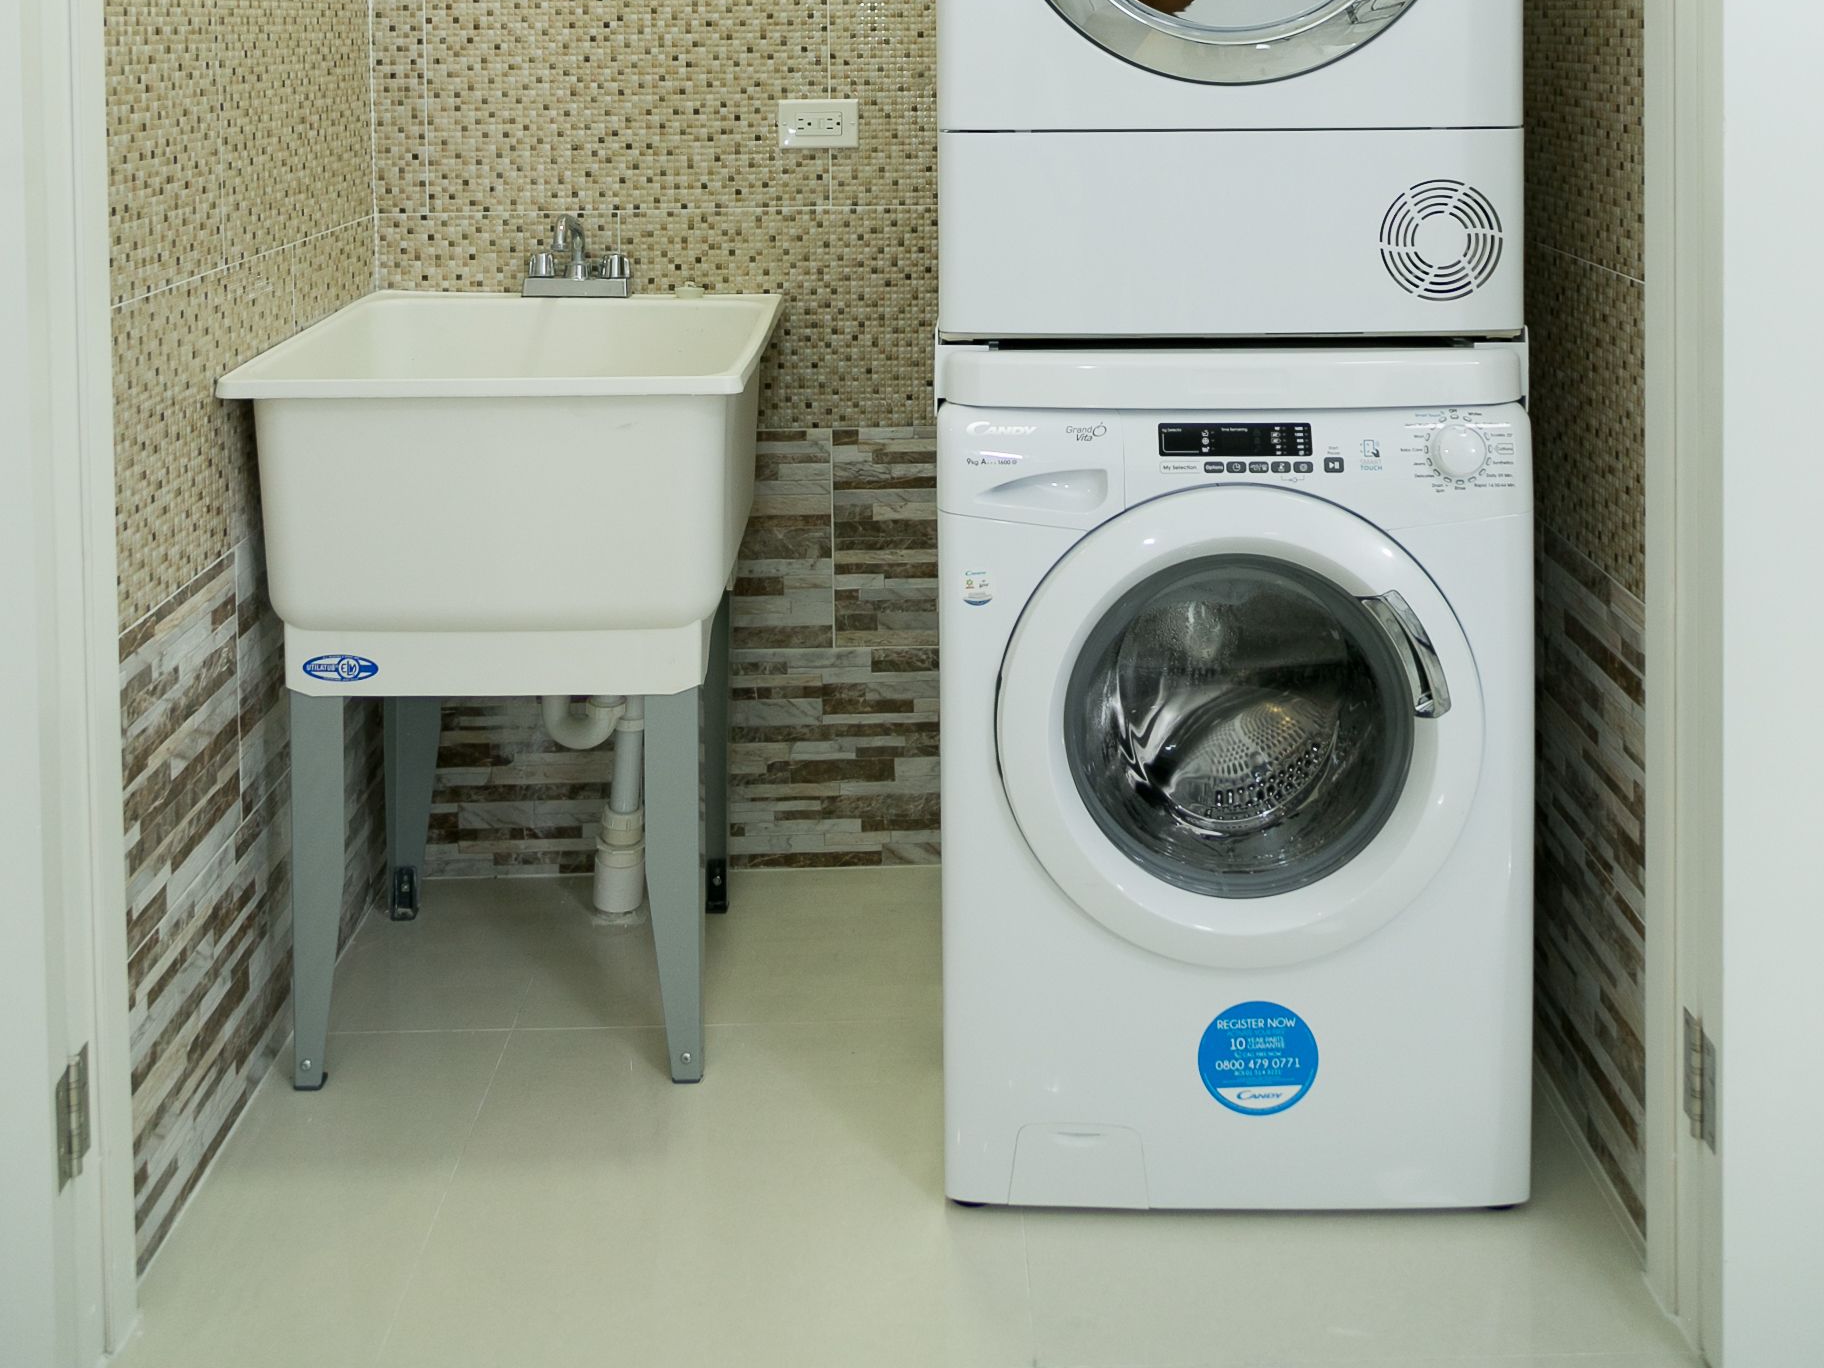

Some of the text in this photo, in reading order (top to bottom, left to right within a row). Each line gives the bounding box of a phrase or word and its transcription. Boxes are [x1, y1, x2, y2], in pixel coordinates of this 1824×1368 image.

[966, 421, 1037, 435] CANDY
[1076, 434, 1093, 442] Vita
[1217, 1017, 1296, 1029] REGISTER NOW
[1230, 1037, 1246, 1050] 10
[1215, 1057, 1300, 1070] 0800 479 0771
[1236, 1090, 1282, 1100] CANDY
